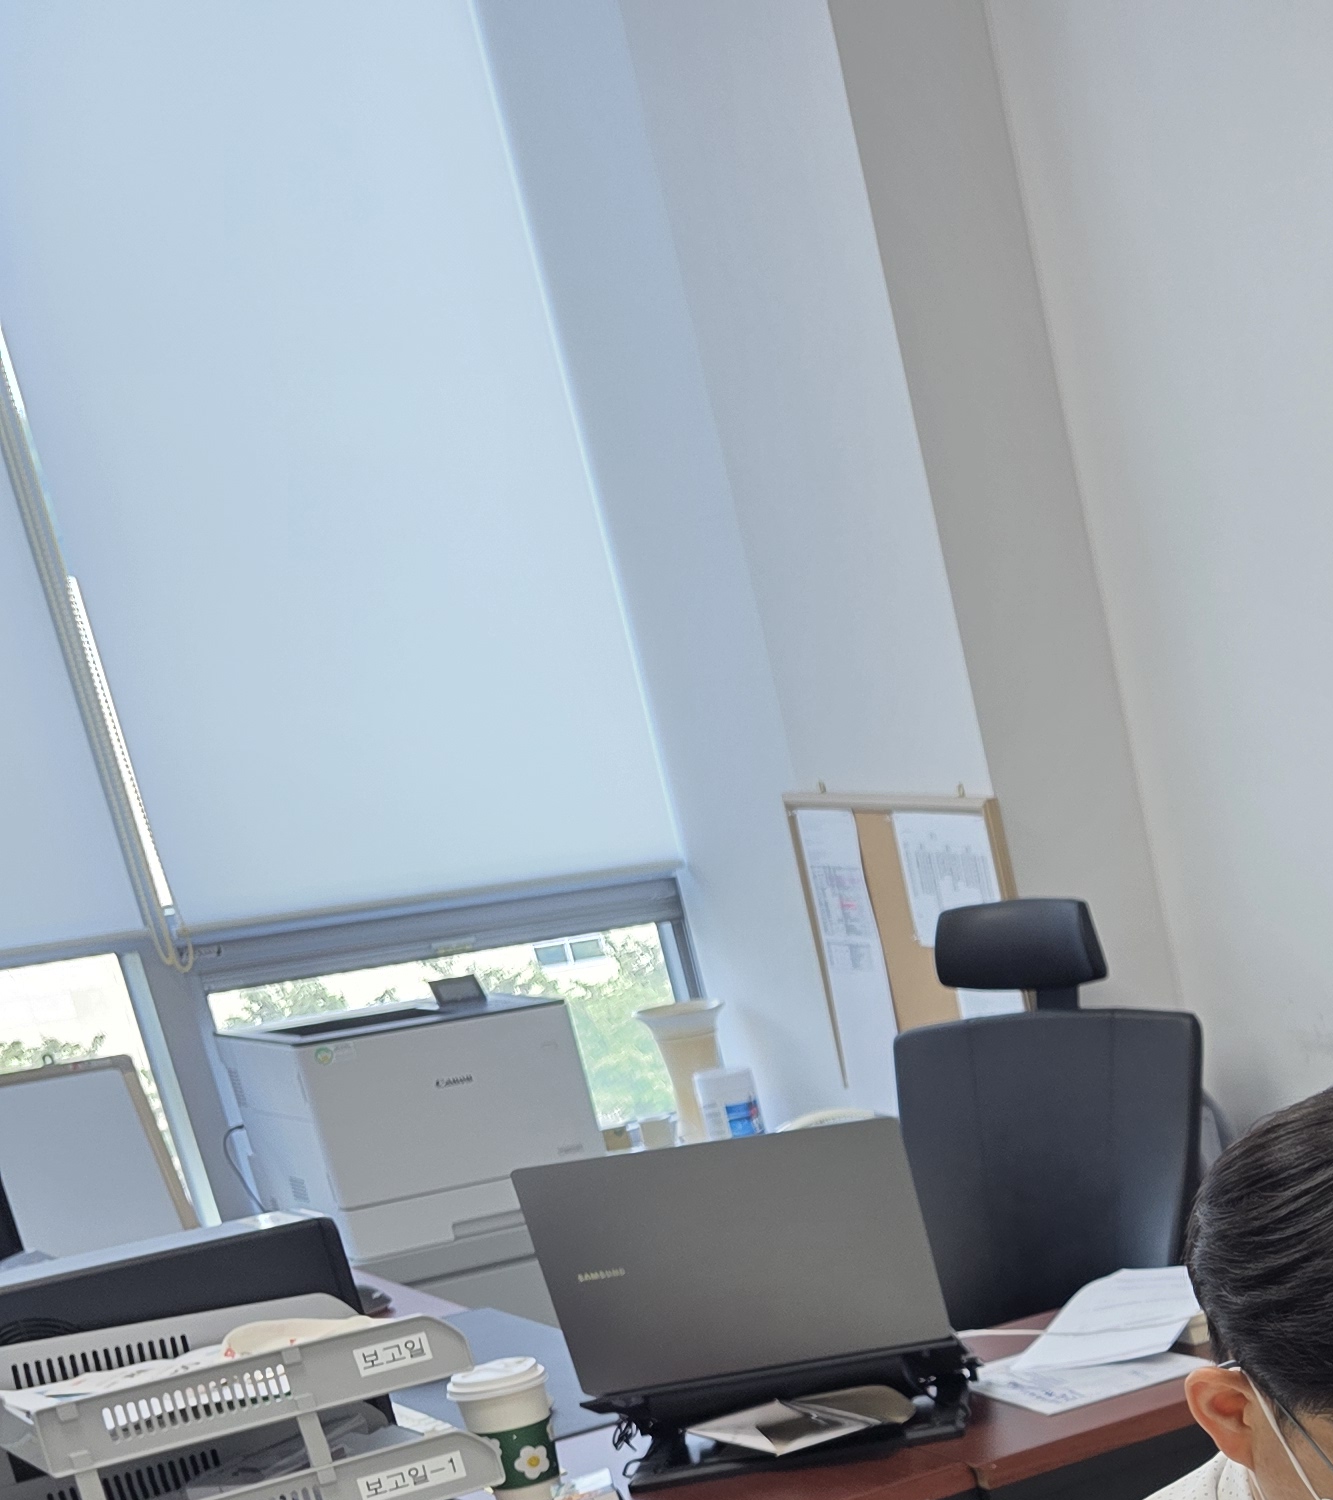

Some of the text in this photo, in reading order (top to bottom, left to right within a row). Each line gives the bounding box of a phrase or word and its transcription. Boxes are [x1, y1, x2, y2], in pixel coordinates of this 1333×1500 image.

[577, 1267, 626, 1283] SAMSUNG
[361, 1336, 427, 1371] 보고일
[365, 1456, 458, 1498] 보고일-1
